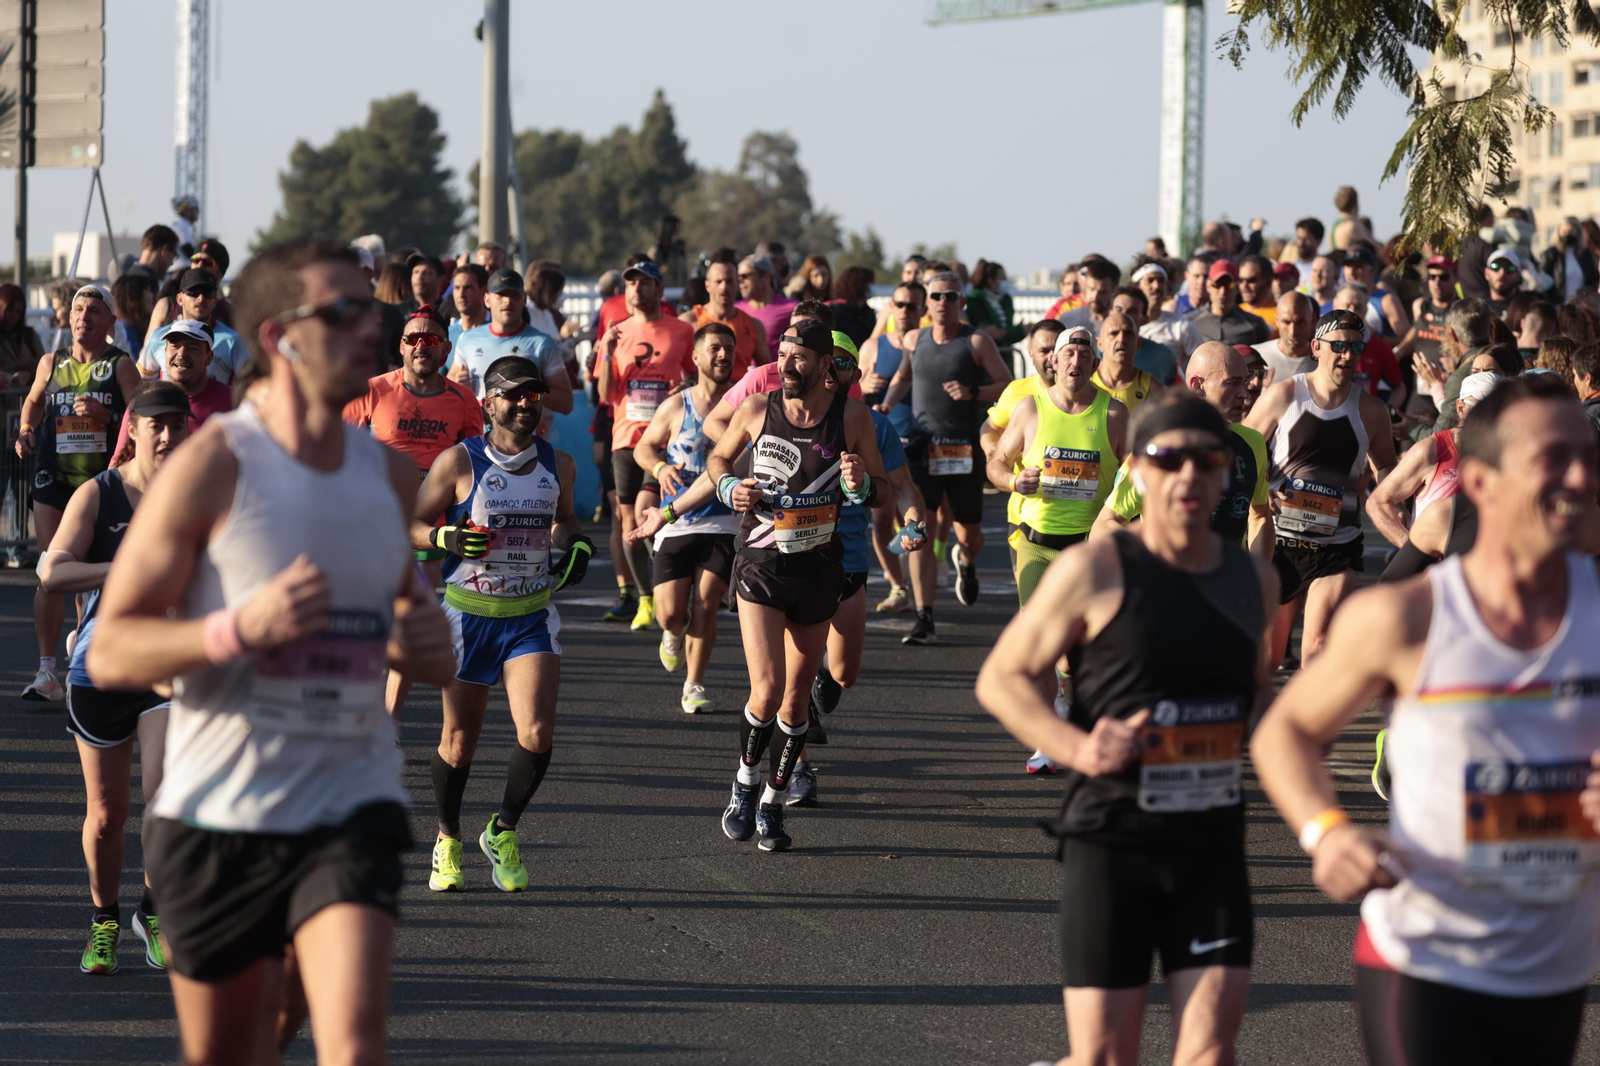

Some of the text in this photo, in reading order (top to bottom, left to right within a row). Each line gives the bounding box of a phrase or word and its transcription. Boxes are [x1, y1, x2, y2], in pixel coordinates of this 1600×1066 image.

[71, 422, 89, 430] 5571
[397, 417, 449, 434] BREAK
[761, 441, 799, 464] ARRASATE
[1062, 451, 1094, 460] ZURICH
[760, 449, 796, 471] RUNNERS
[1061, 467, 1081, 476] 4642
[1060, 480, 1079, 488] SINKO
[1305, 483, 1337, 496] ZURICH
[795, 496, 831, 506] ZURICH
[1302, 499, 1323, 511] 5442
[796, 515, 818, 525] 3760
[1303, 513, 1317, 521] IAIN
[795, 528, 819, 538] SERLLY
[506, 536, 530, 547] 5874
[507, 552, 528, 561] RAÚL
